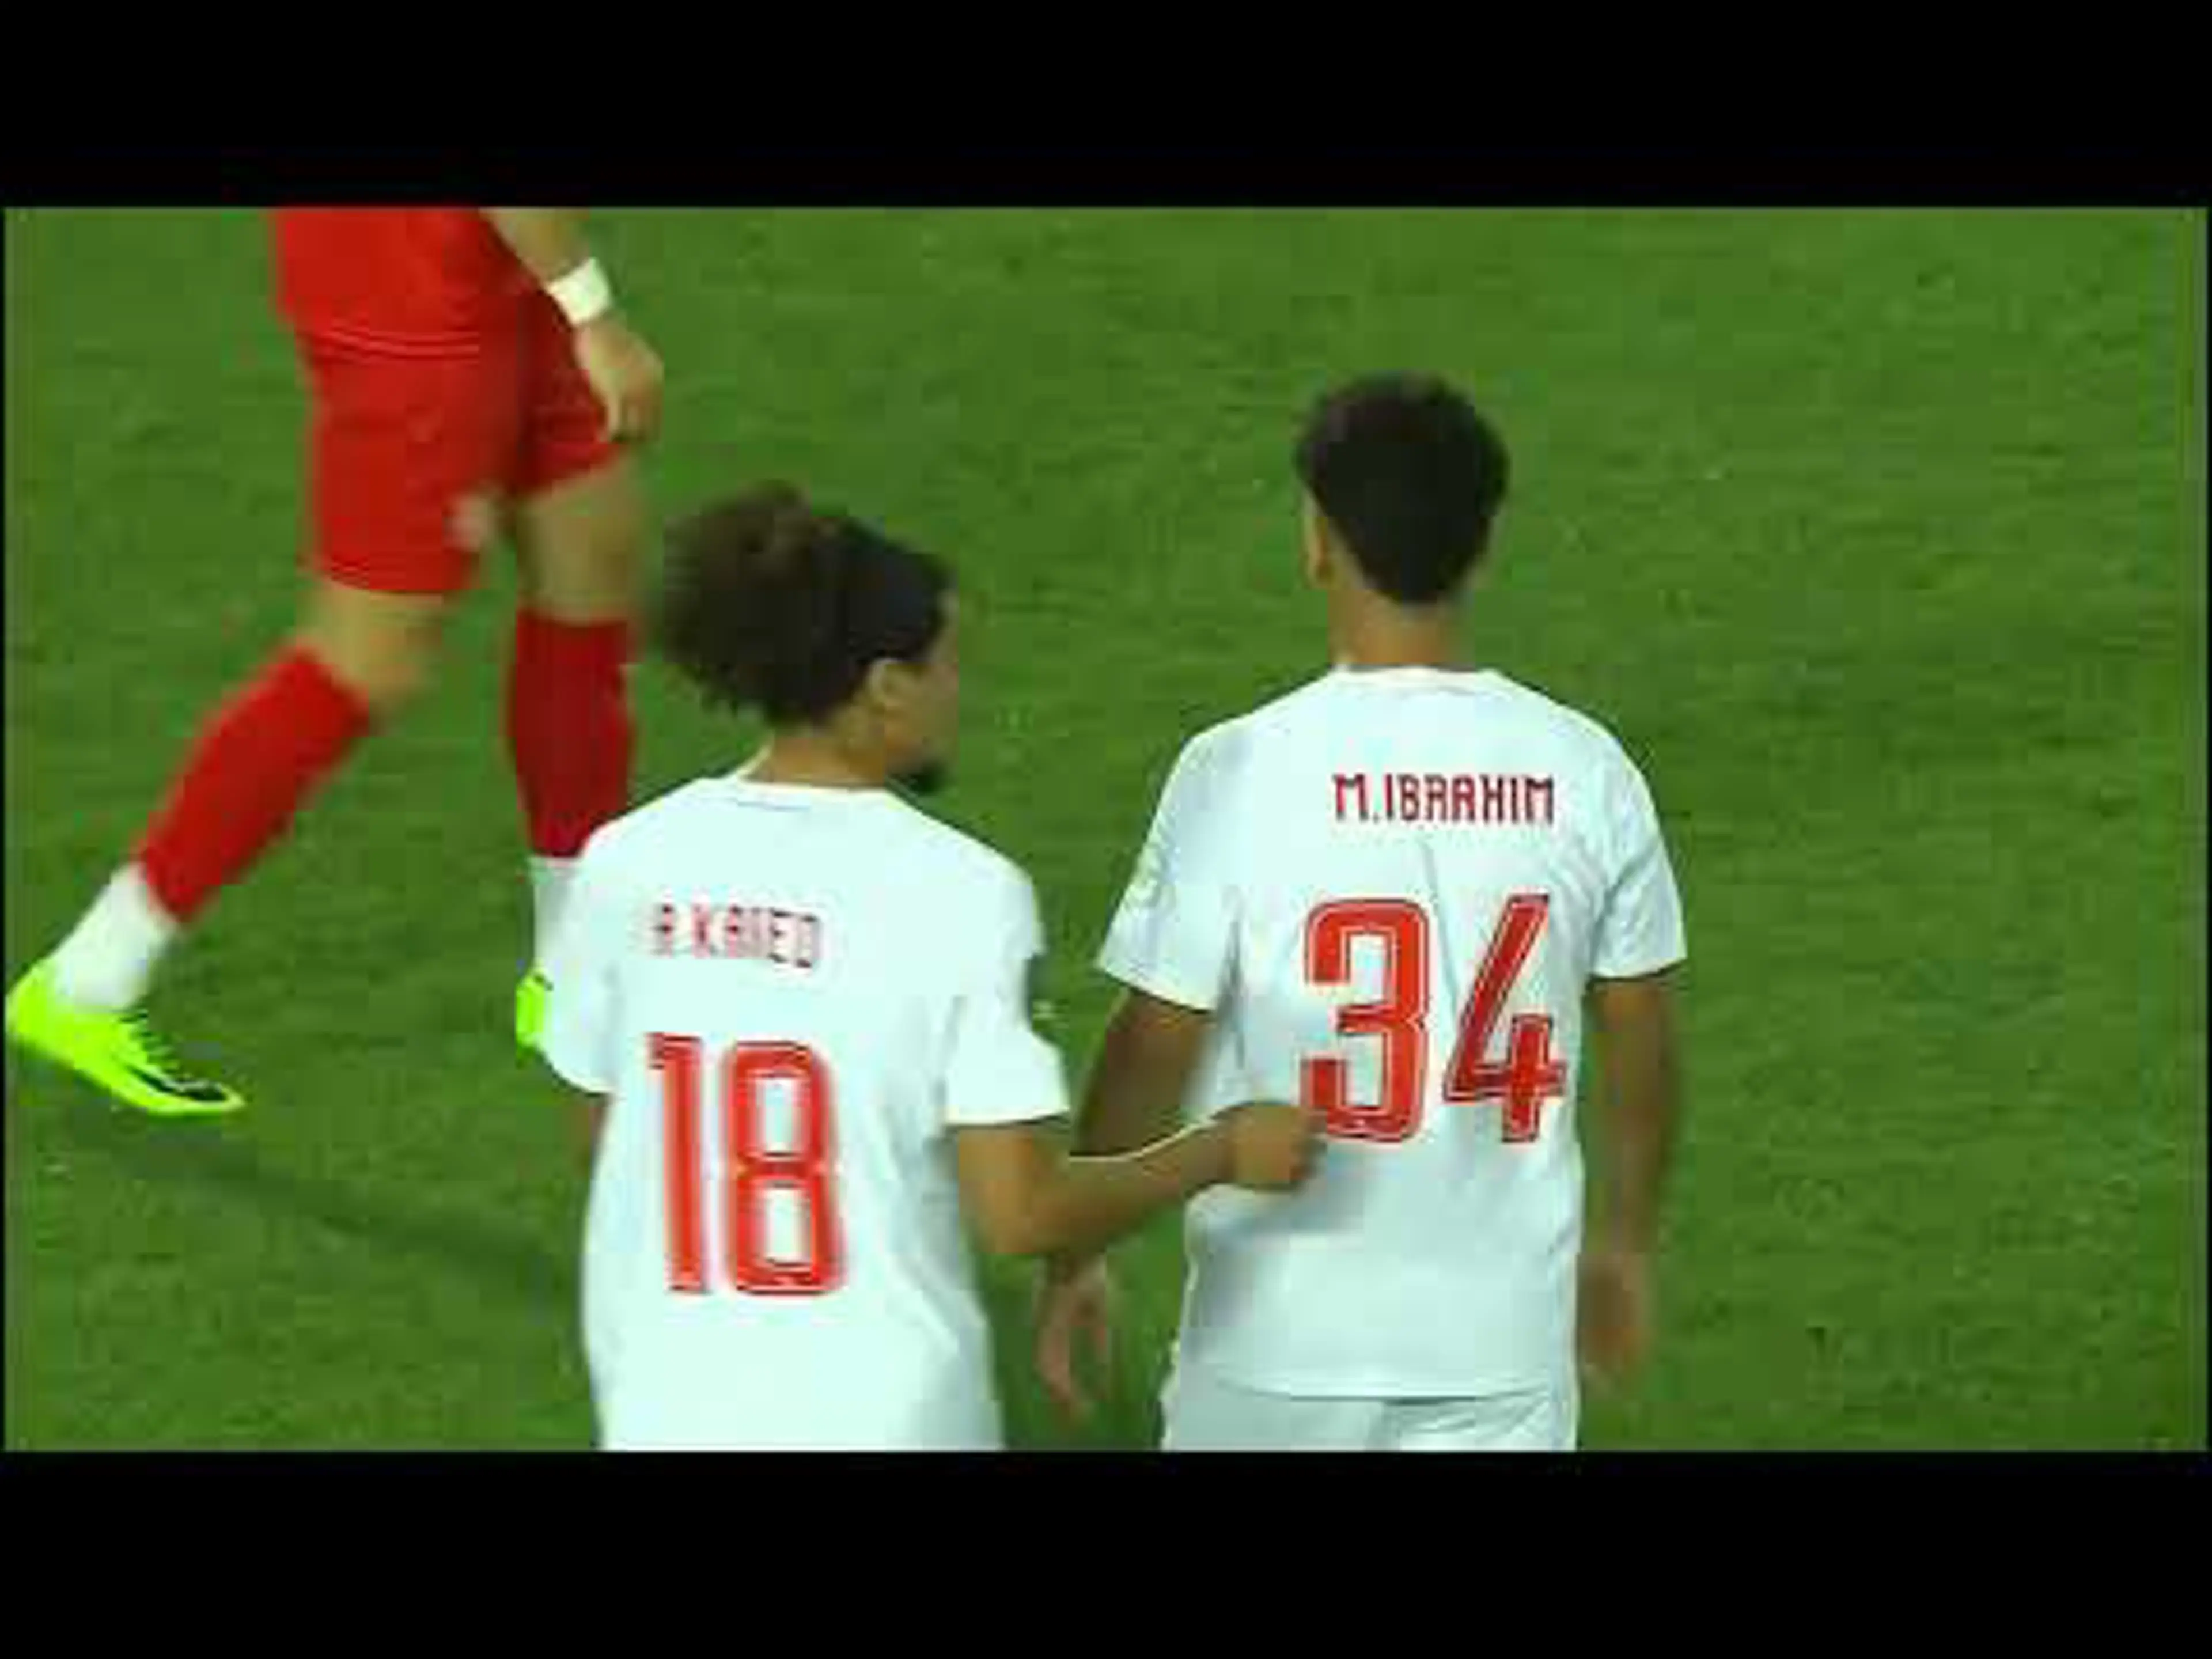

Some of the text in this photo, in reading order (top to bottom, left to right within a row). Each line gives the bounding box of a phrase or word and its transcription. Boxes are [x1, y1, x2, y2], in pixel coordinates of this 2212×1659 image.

[1332, 773, 1554, 824] M.IBRAHIM
[1300, 894, 1566, 1143] 34
[645, 1032, 846, 1294] 18
